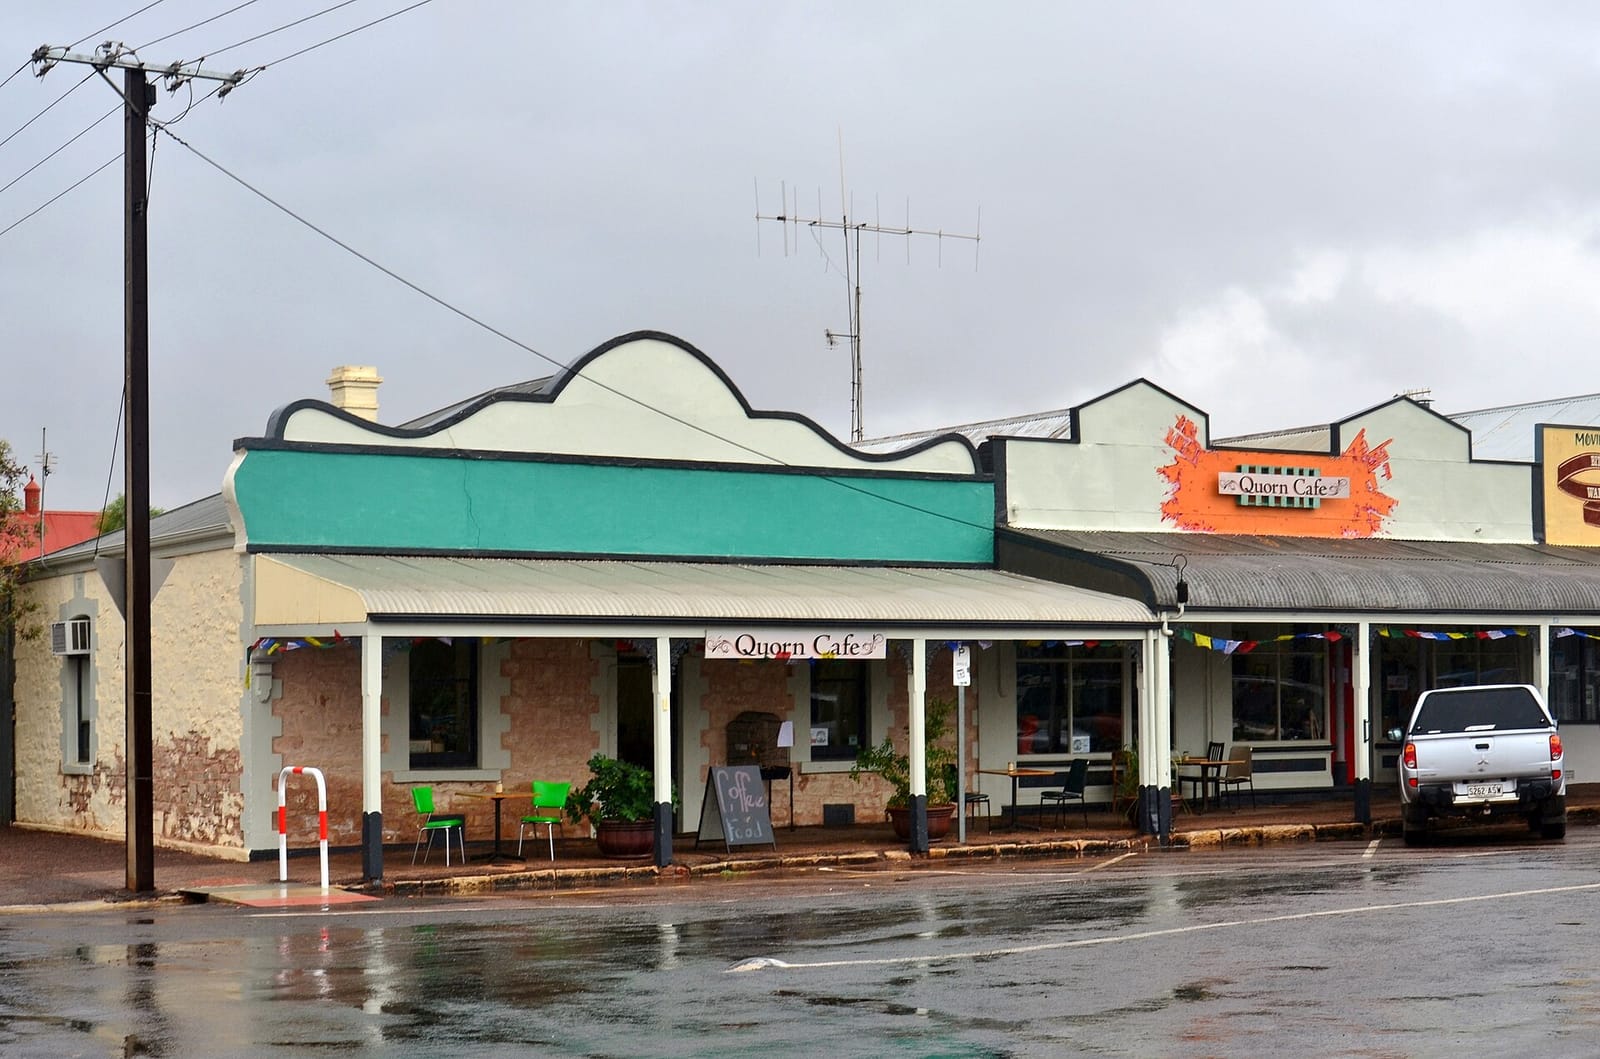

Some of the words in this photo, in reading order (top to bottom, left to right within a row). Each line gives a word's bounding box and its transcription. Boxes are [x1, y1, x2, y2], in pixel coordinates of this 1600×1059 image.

[1575, 433, 1600, 447] MOVI
[1239, 475, 1288, 494] Quorn
[1293, 478, 1328, 496] Cafe
[735, 633, 805, 657] Quorn
[813, 633, 861, 656] Cafe
[958, 647, 965, 657] P
[716, 769, 765, 813] Coffee
